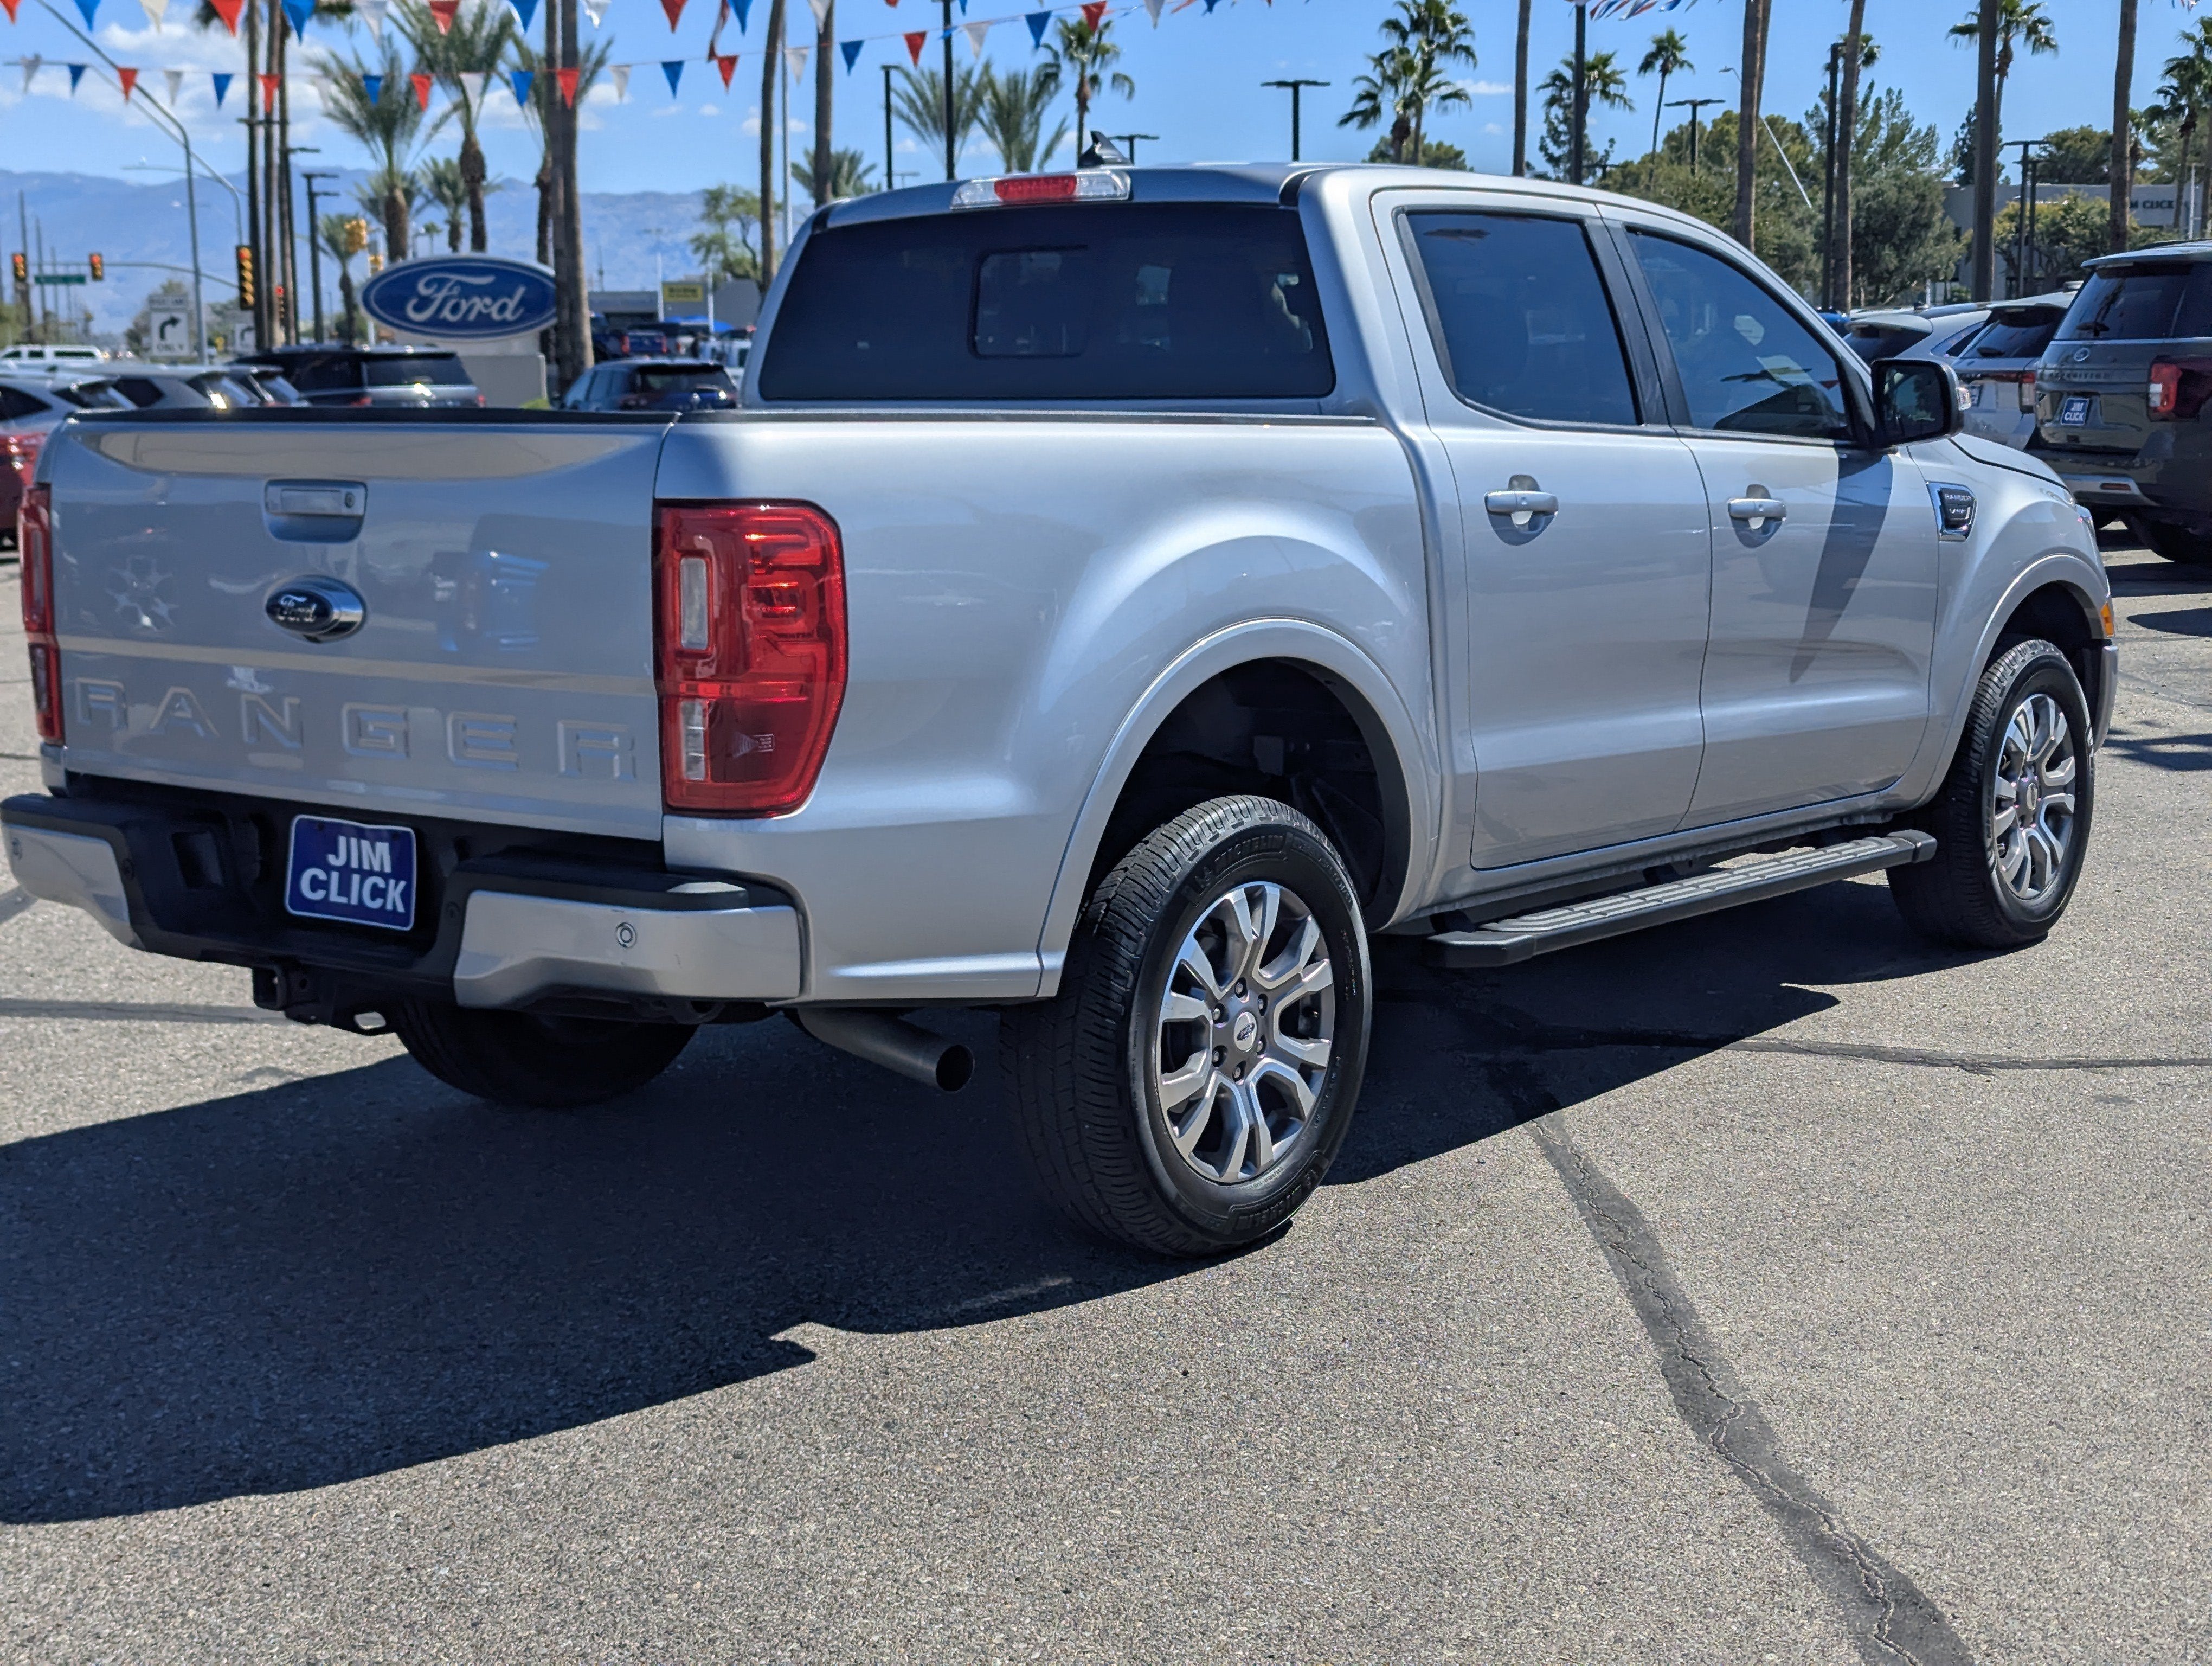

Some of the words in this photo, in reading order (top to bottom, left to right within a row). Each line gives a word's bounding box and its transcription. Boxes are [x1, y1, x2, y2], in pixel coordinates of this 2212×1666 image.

[2143, 200, 2174, 209] CLICK
[407, 273, 526, 322] Ford
[2064, 411, 2085, 421] CLICK
[75, 677, 637, 782] RANGER
[327, 835, 391, 873] JIM
[300, 868, 407, 913] CLICK
